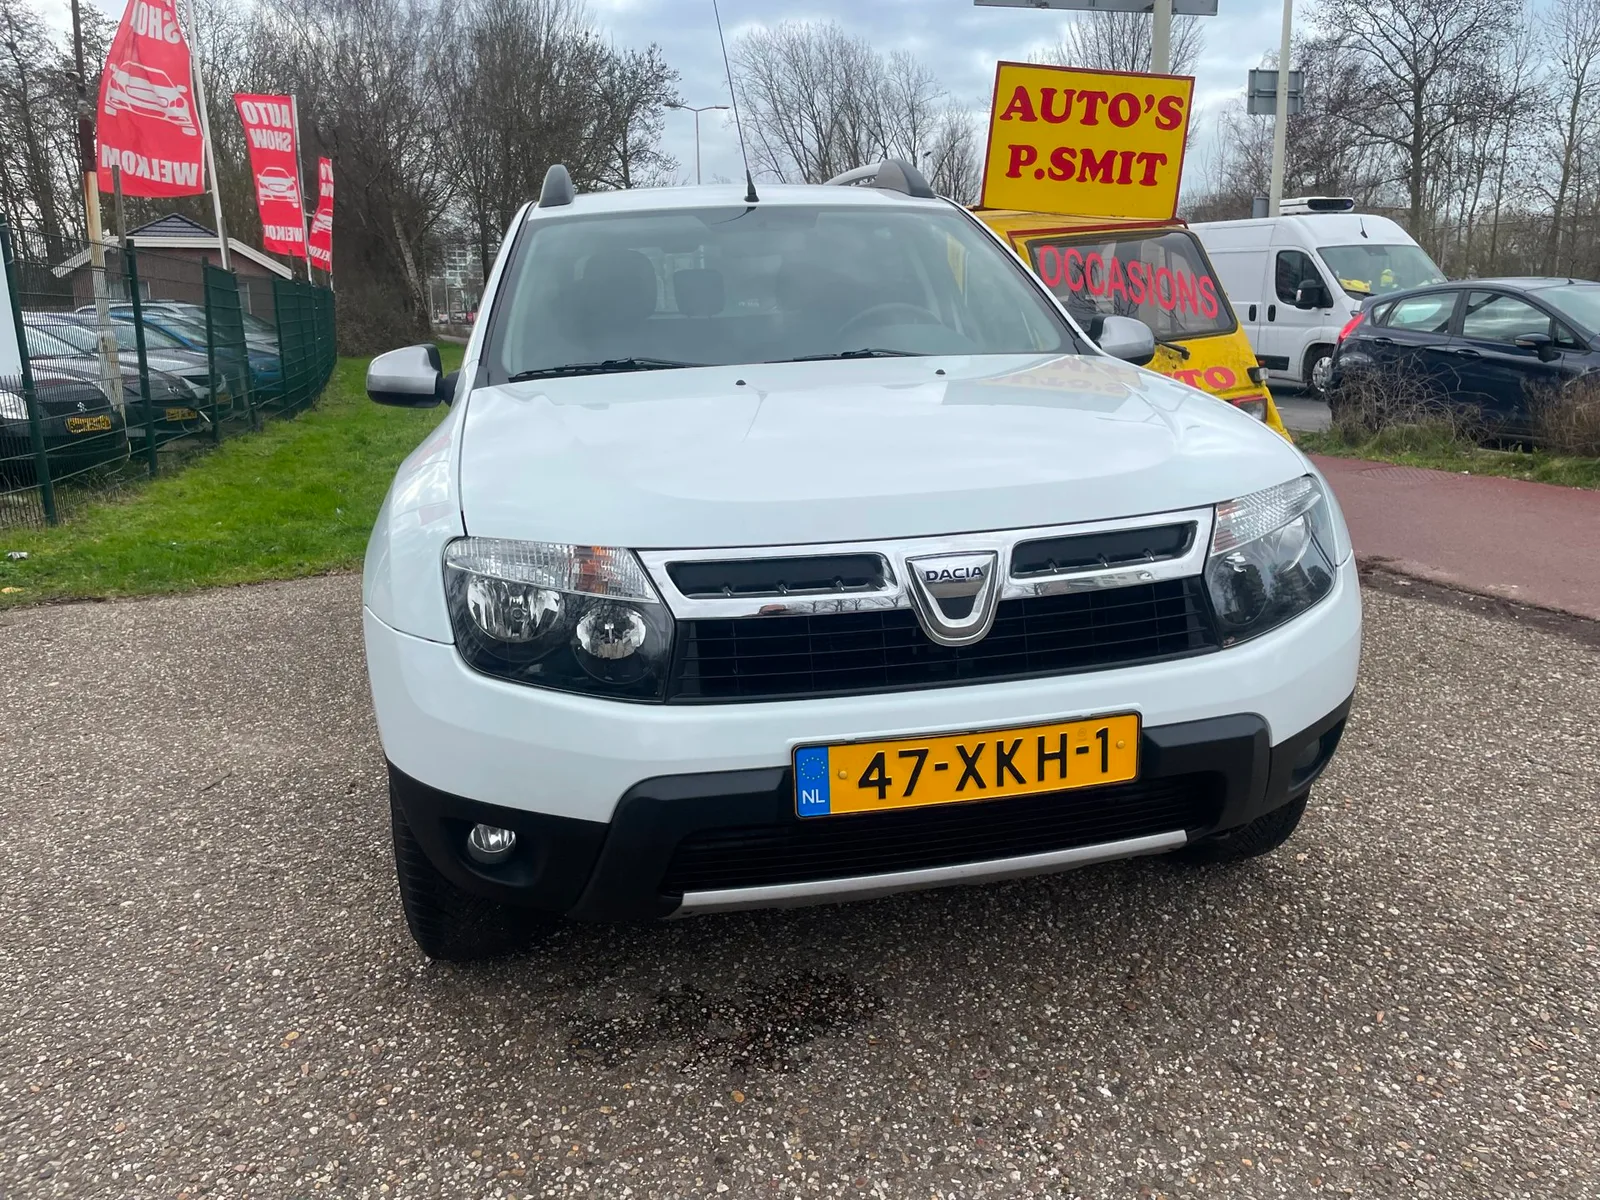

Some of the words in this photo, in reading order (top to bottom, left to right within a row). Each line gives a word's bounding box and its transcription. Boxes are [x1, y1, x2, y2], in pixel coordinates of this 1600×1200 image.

[1000, 85, 1184, 131] AUTO'S
[1005, 144, 1167, 187] P.SMIT
[1039, 245, 1219, 320] OCCASIONS
[1163, 366, 1236, 389] TO
[925, 564, 985, 582] DACIA
[857, 726, 1109, 800] 47-XKH-1
[802, 789, 826, 805] NL
